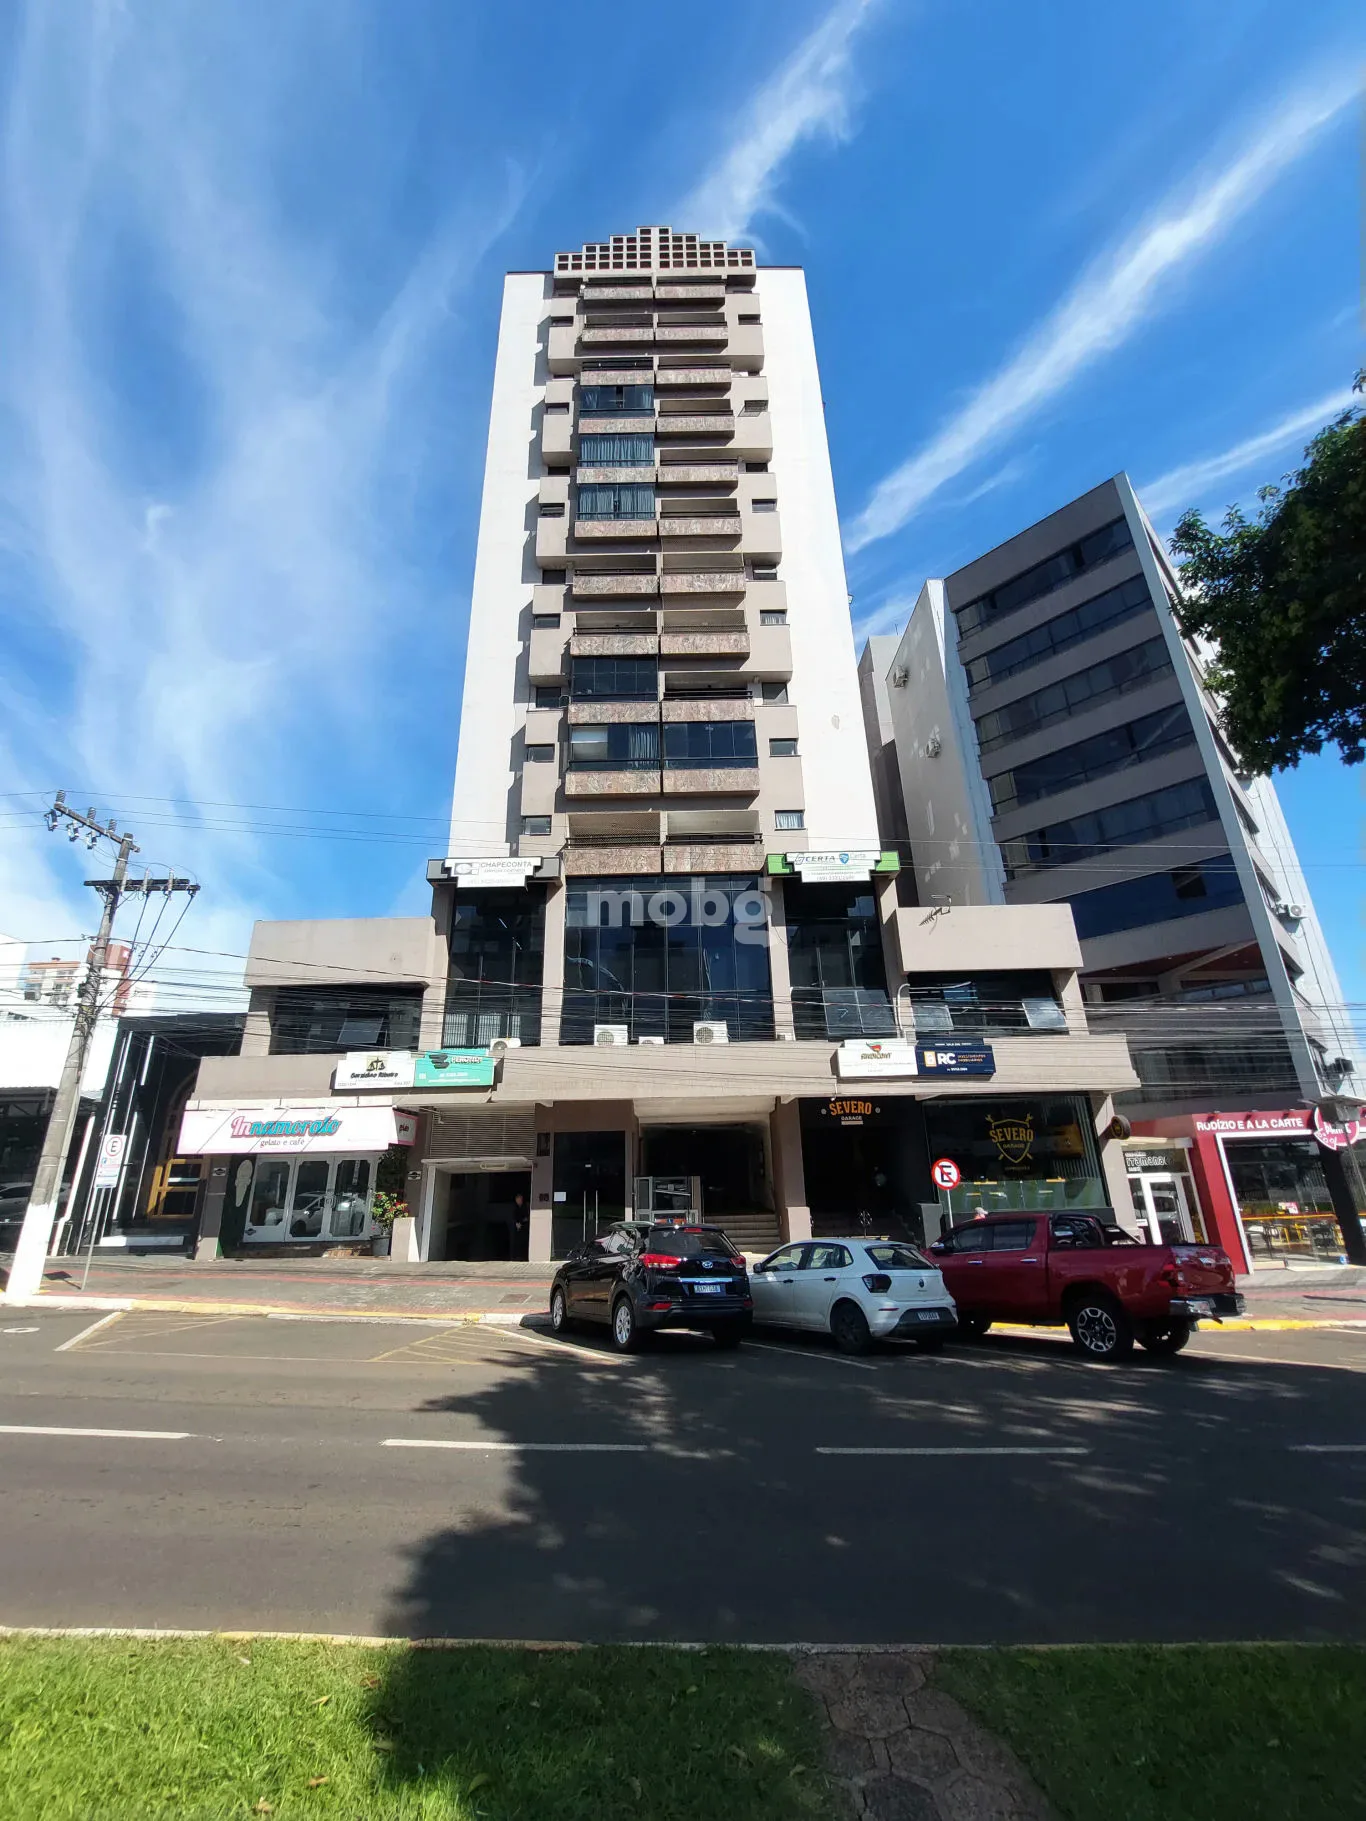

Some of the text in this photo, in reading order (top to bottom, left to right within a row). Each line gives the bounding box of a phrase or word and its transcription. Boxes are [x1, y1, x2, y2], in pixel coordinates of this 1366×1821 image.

[480, 861, 533, 869] CHAPECONTA
[805, 856, 836, 864] CERTA
[937, 1052, 957, 1065] RC
[829, 1100, 872, 1116] SEVERO
[1196, 1117, 1304, 1131] RODÍZIO E A LA CARTE
[989, 1127, 1034, 1143] SEVERO
[110, 1141, 118, 1153] E
[260, 1138, 281, 1148] gelato
[940, 1165, 952, 1183] E
